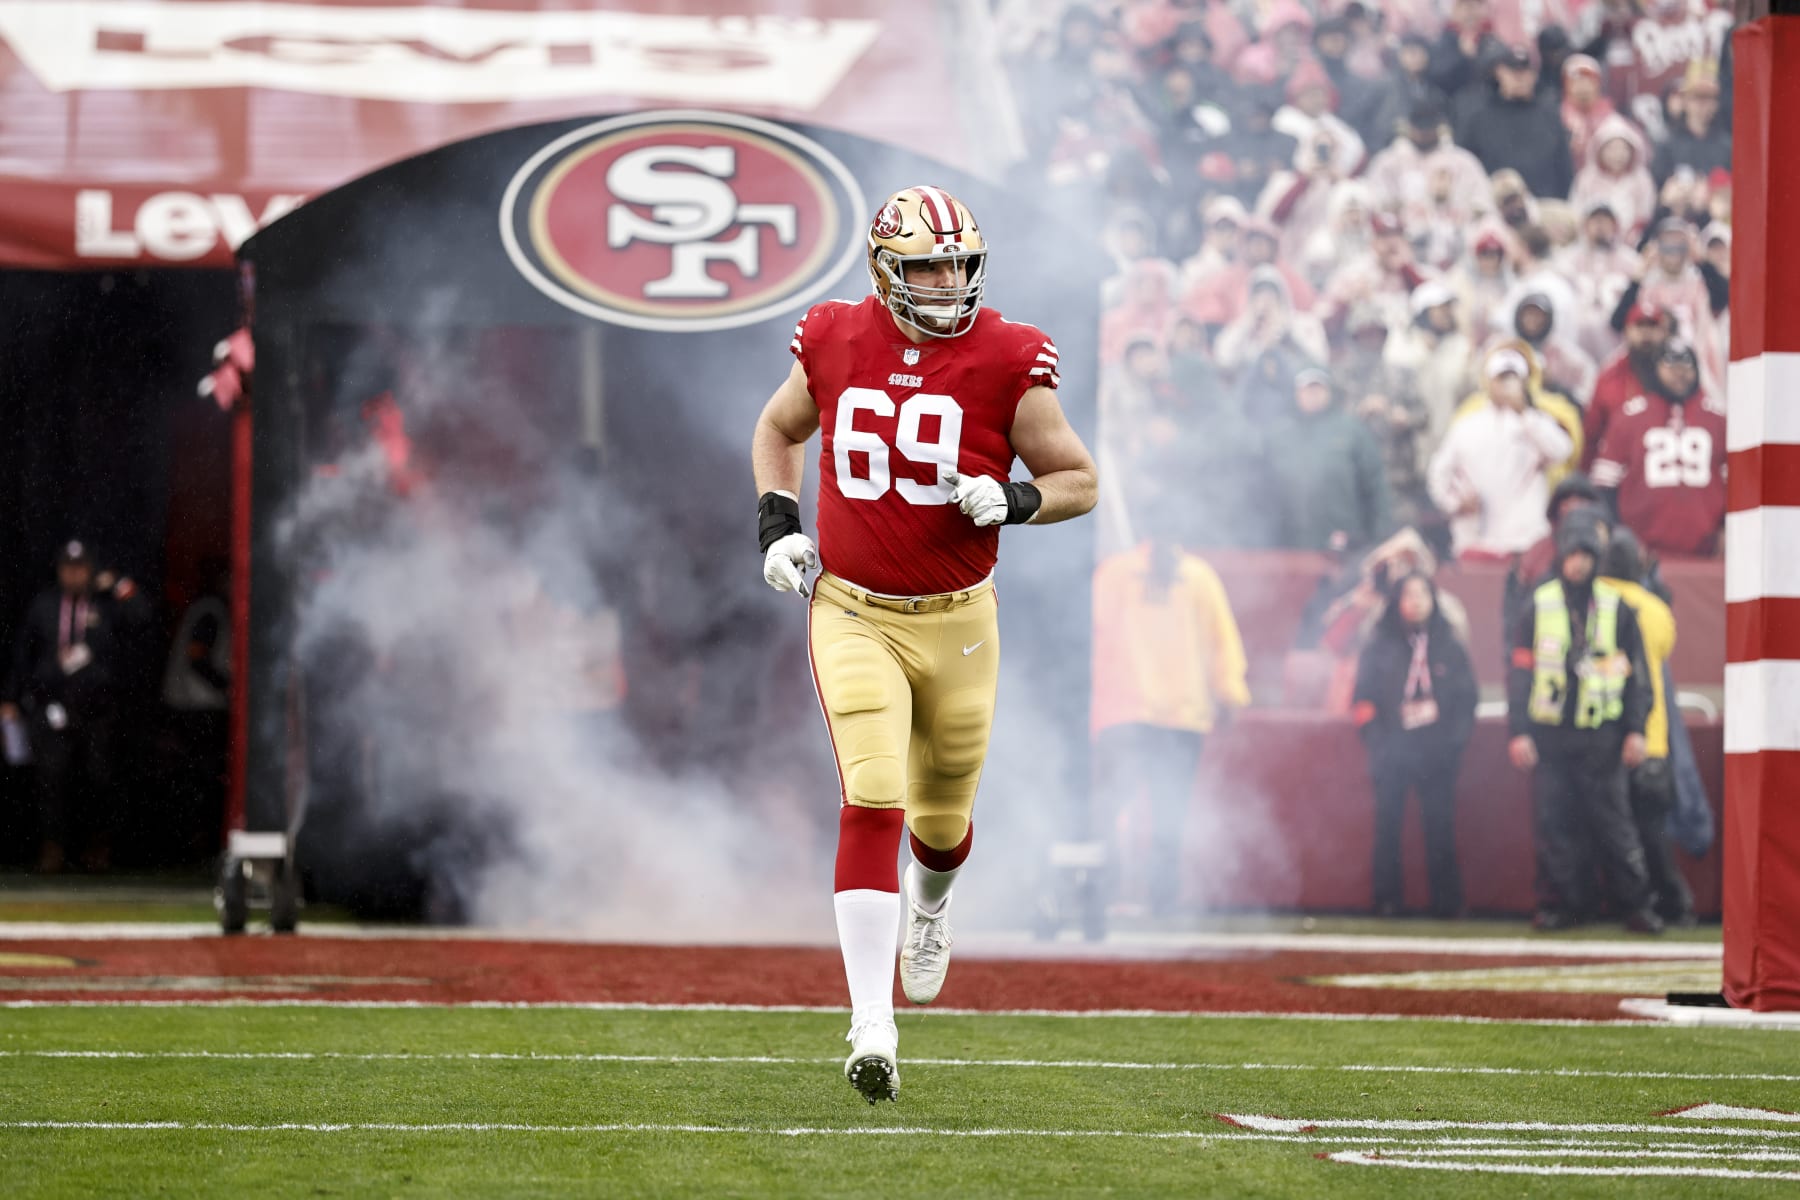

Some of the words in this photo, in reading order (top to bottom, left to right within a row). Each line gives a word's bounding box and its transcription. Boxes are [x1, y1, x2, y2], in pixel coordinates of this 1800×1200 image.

[606, 145, 796, 297] SF
[833, 387, 963, 505] 69
[1643, 427, 1712, 488] 29
